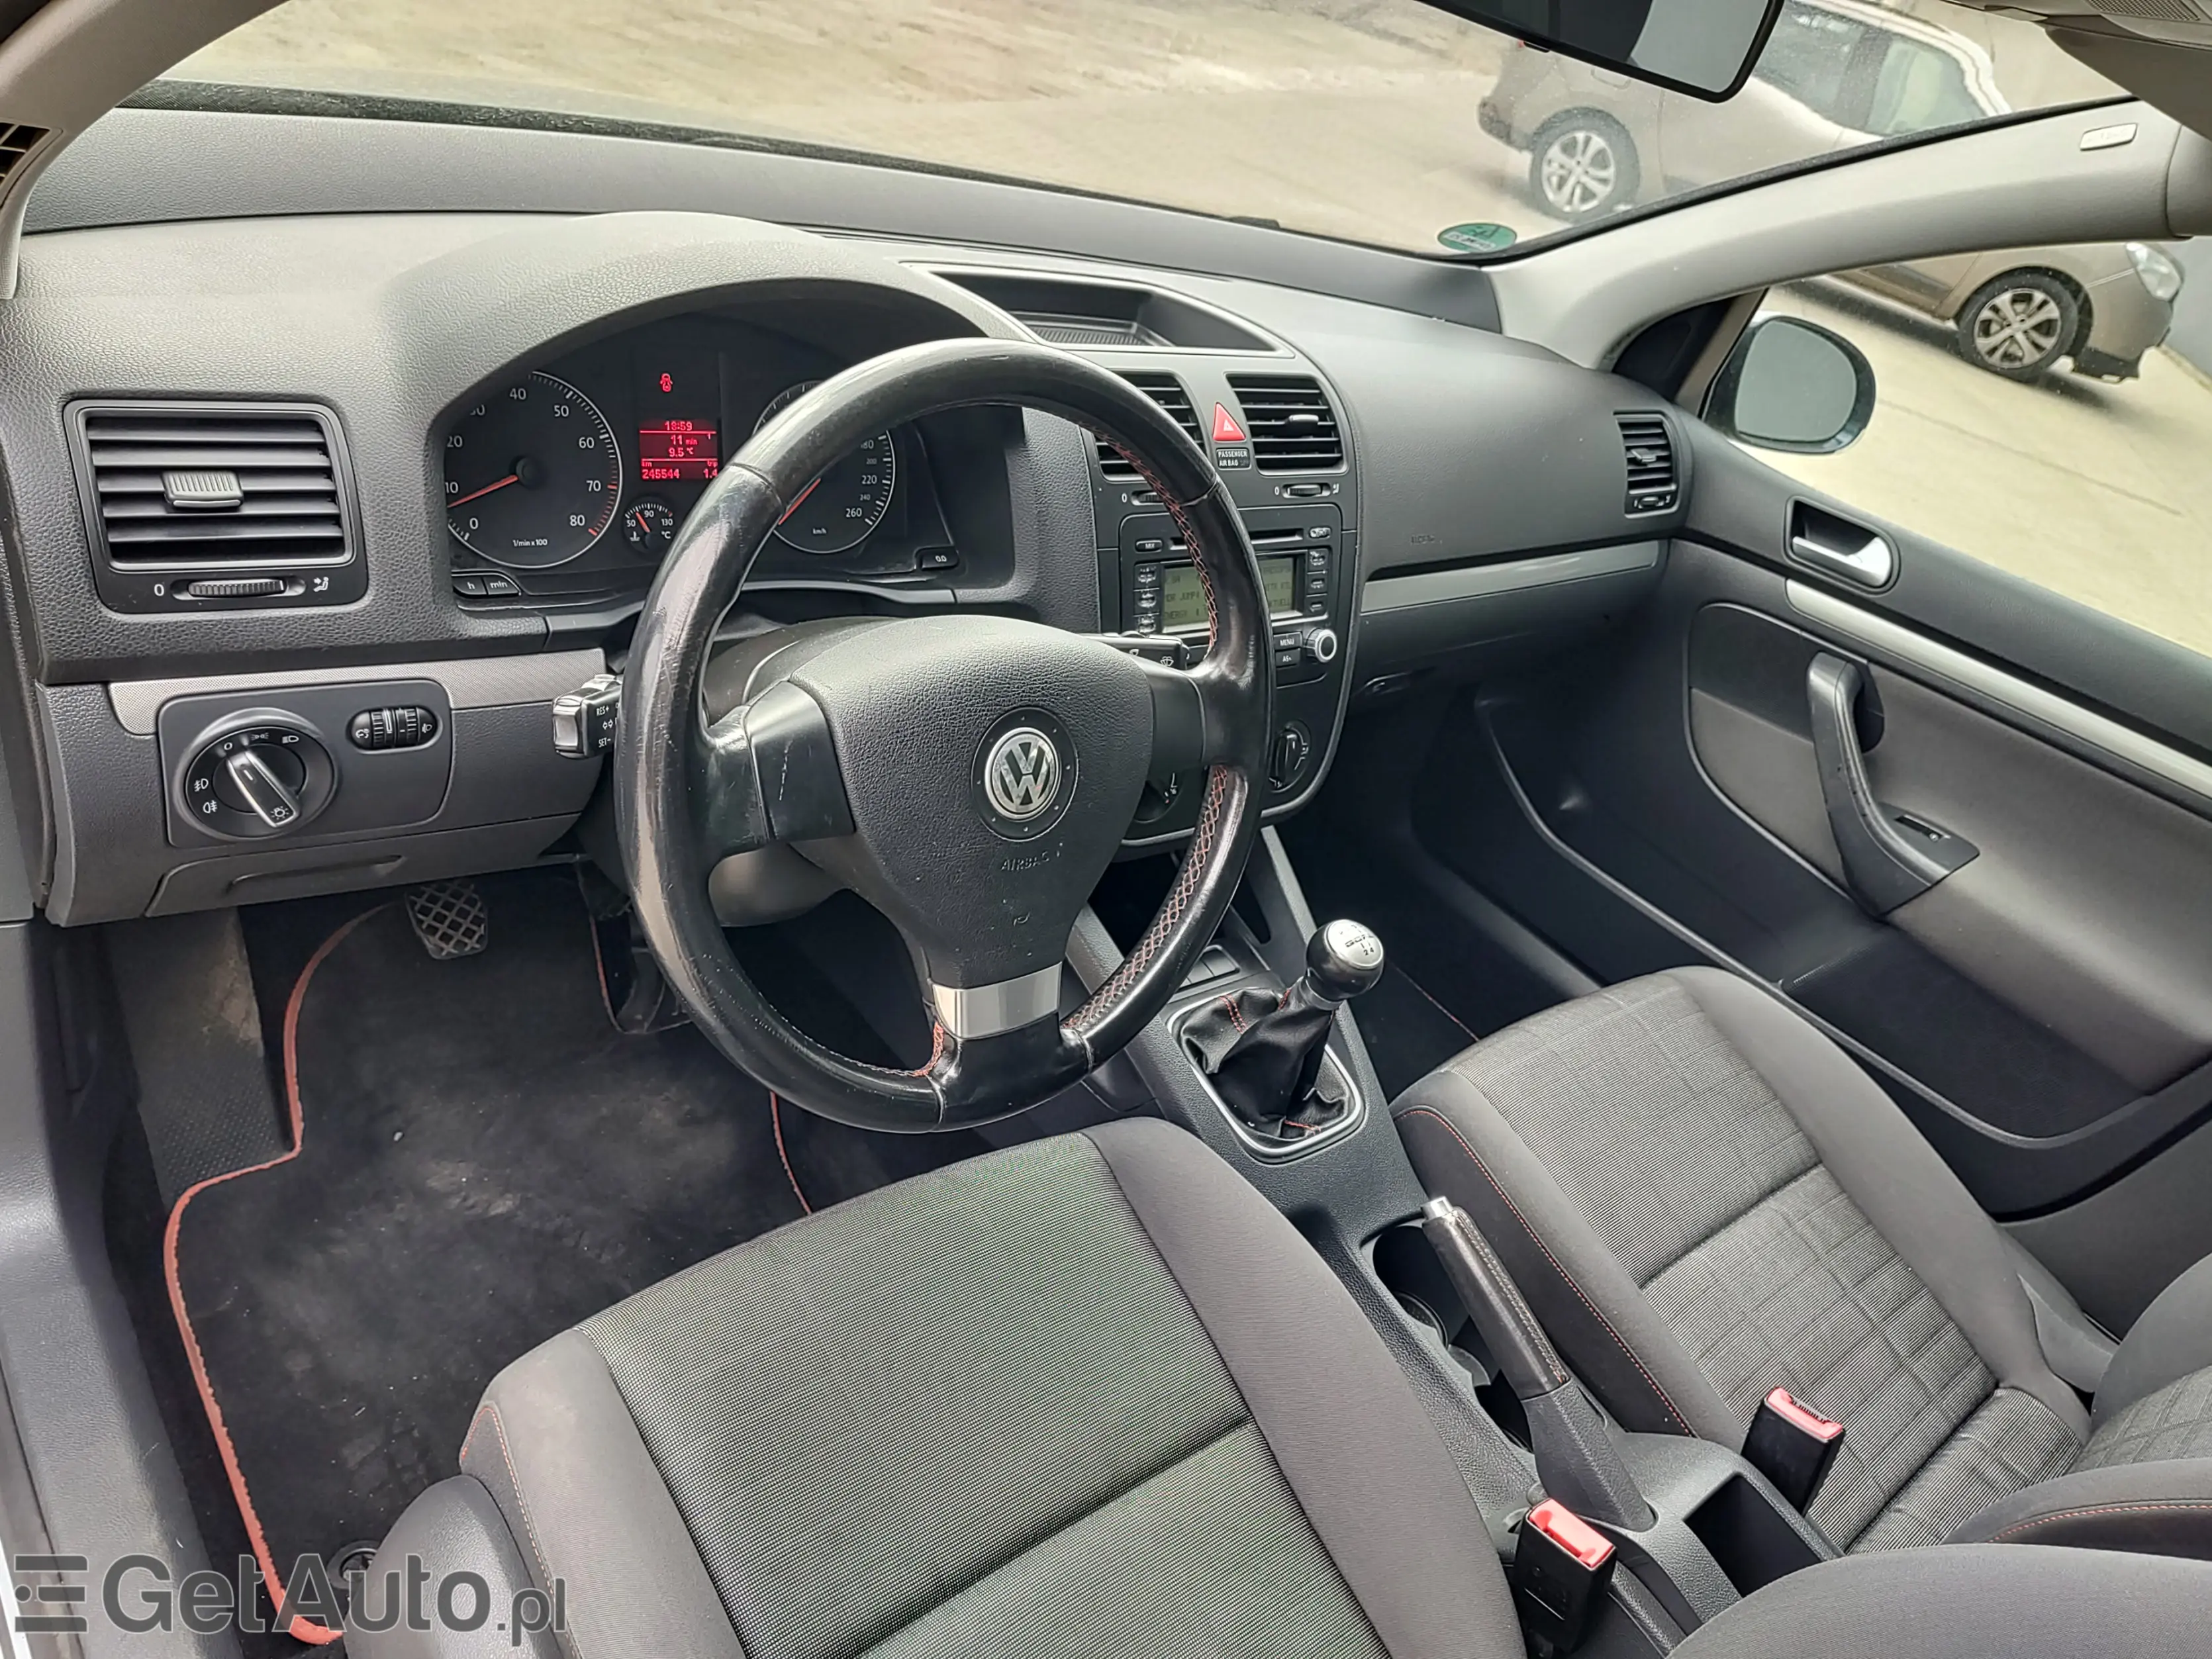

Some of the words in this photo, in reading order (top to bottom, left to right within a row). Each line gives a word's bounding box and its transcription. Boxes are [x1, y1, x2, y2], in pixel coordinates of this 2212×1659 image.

[509, 388, 527, 400] 40
[553, 405, 569, 417] 50
[447, 435, 463, 448] 20
[578, 437, 595, 448] 60
[671, 434, 683, 445] 11
[668, 447, 685, 457] 9.5
[642, 468, 680, 479] 245544
[861, 475, 877, 485] 220
[445, 481, 459, 493] 10
[586, 480, 601, 492] 70
[845, 508, 862, 518] 260
[469, 518, 479, 530] 0
[569, 514, 585, 526] 80
[490, 581, 508, 589] min
